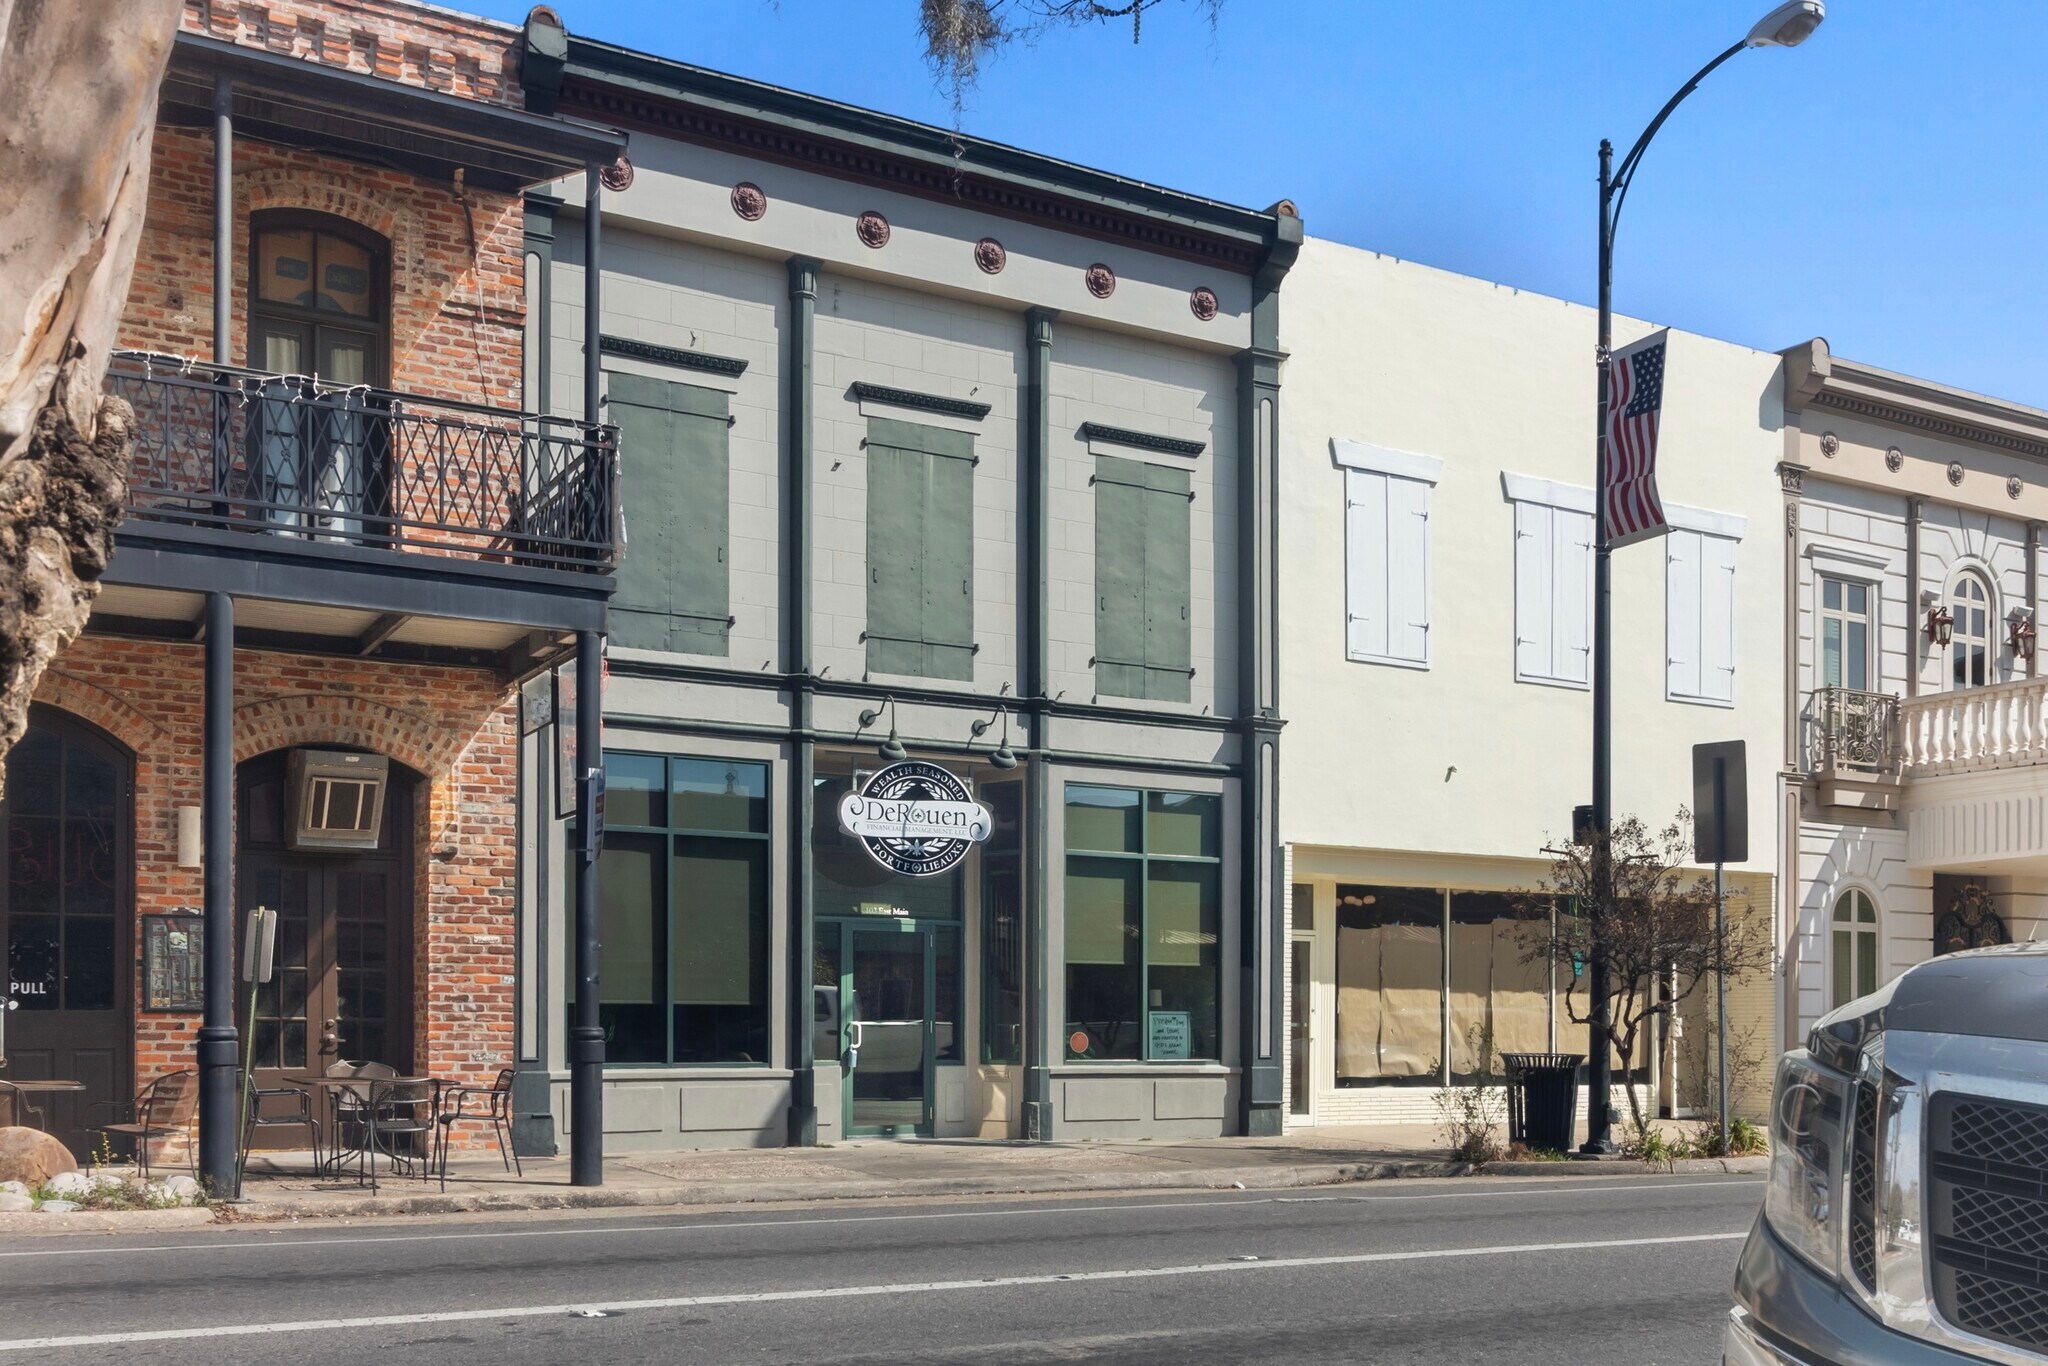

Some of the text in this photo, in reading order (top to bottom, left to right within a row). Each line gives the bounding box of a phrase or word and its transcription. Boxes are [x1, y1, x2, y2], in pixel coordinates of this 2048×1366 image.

[871, 766, 965, 801] WEALTH SEASONED
[867, 801, 968, 827] DeRouen
[866, 823, 902, 832] FINANCIAL
[892, 907, 909, 916] Main
[10, 981, 47, 995] PULL
